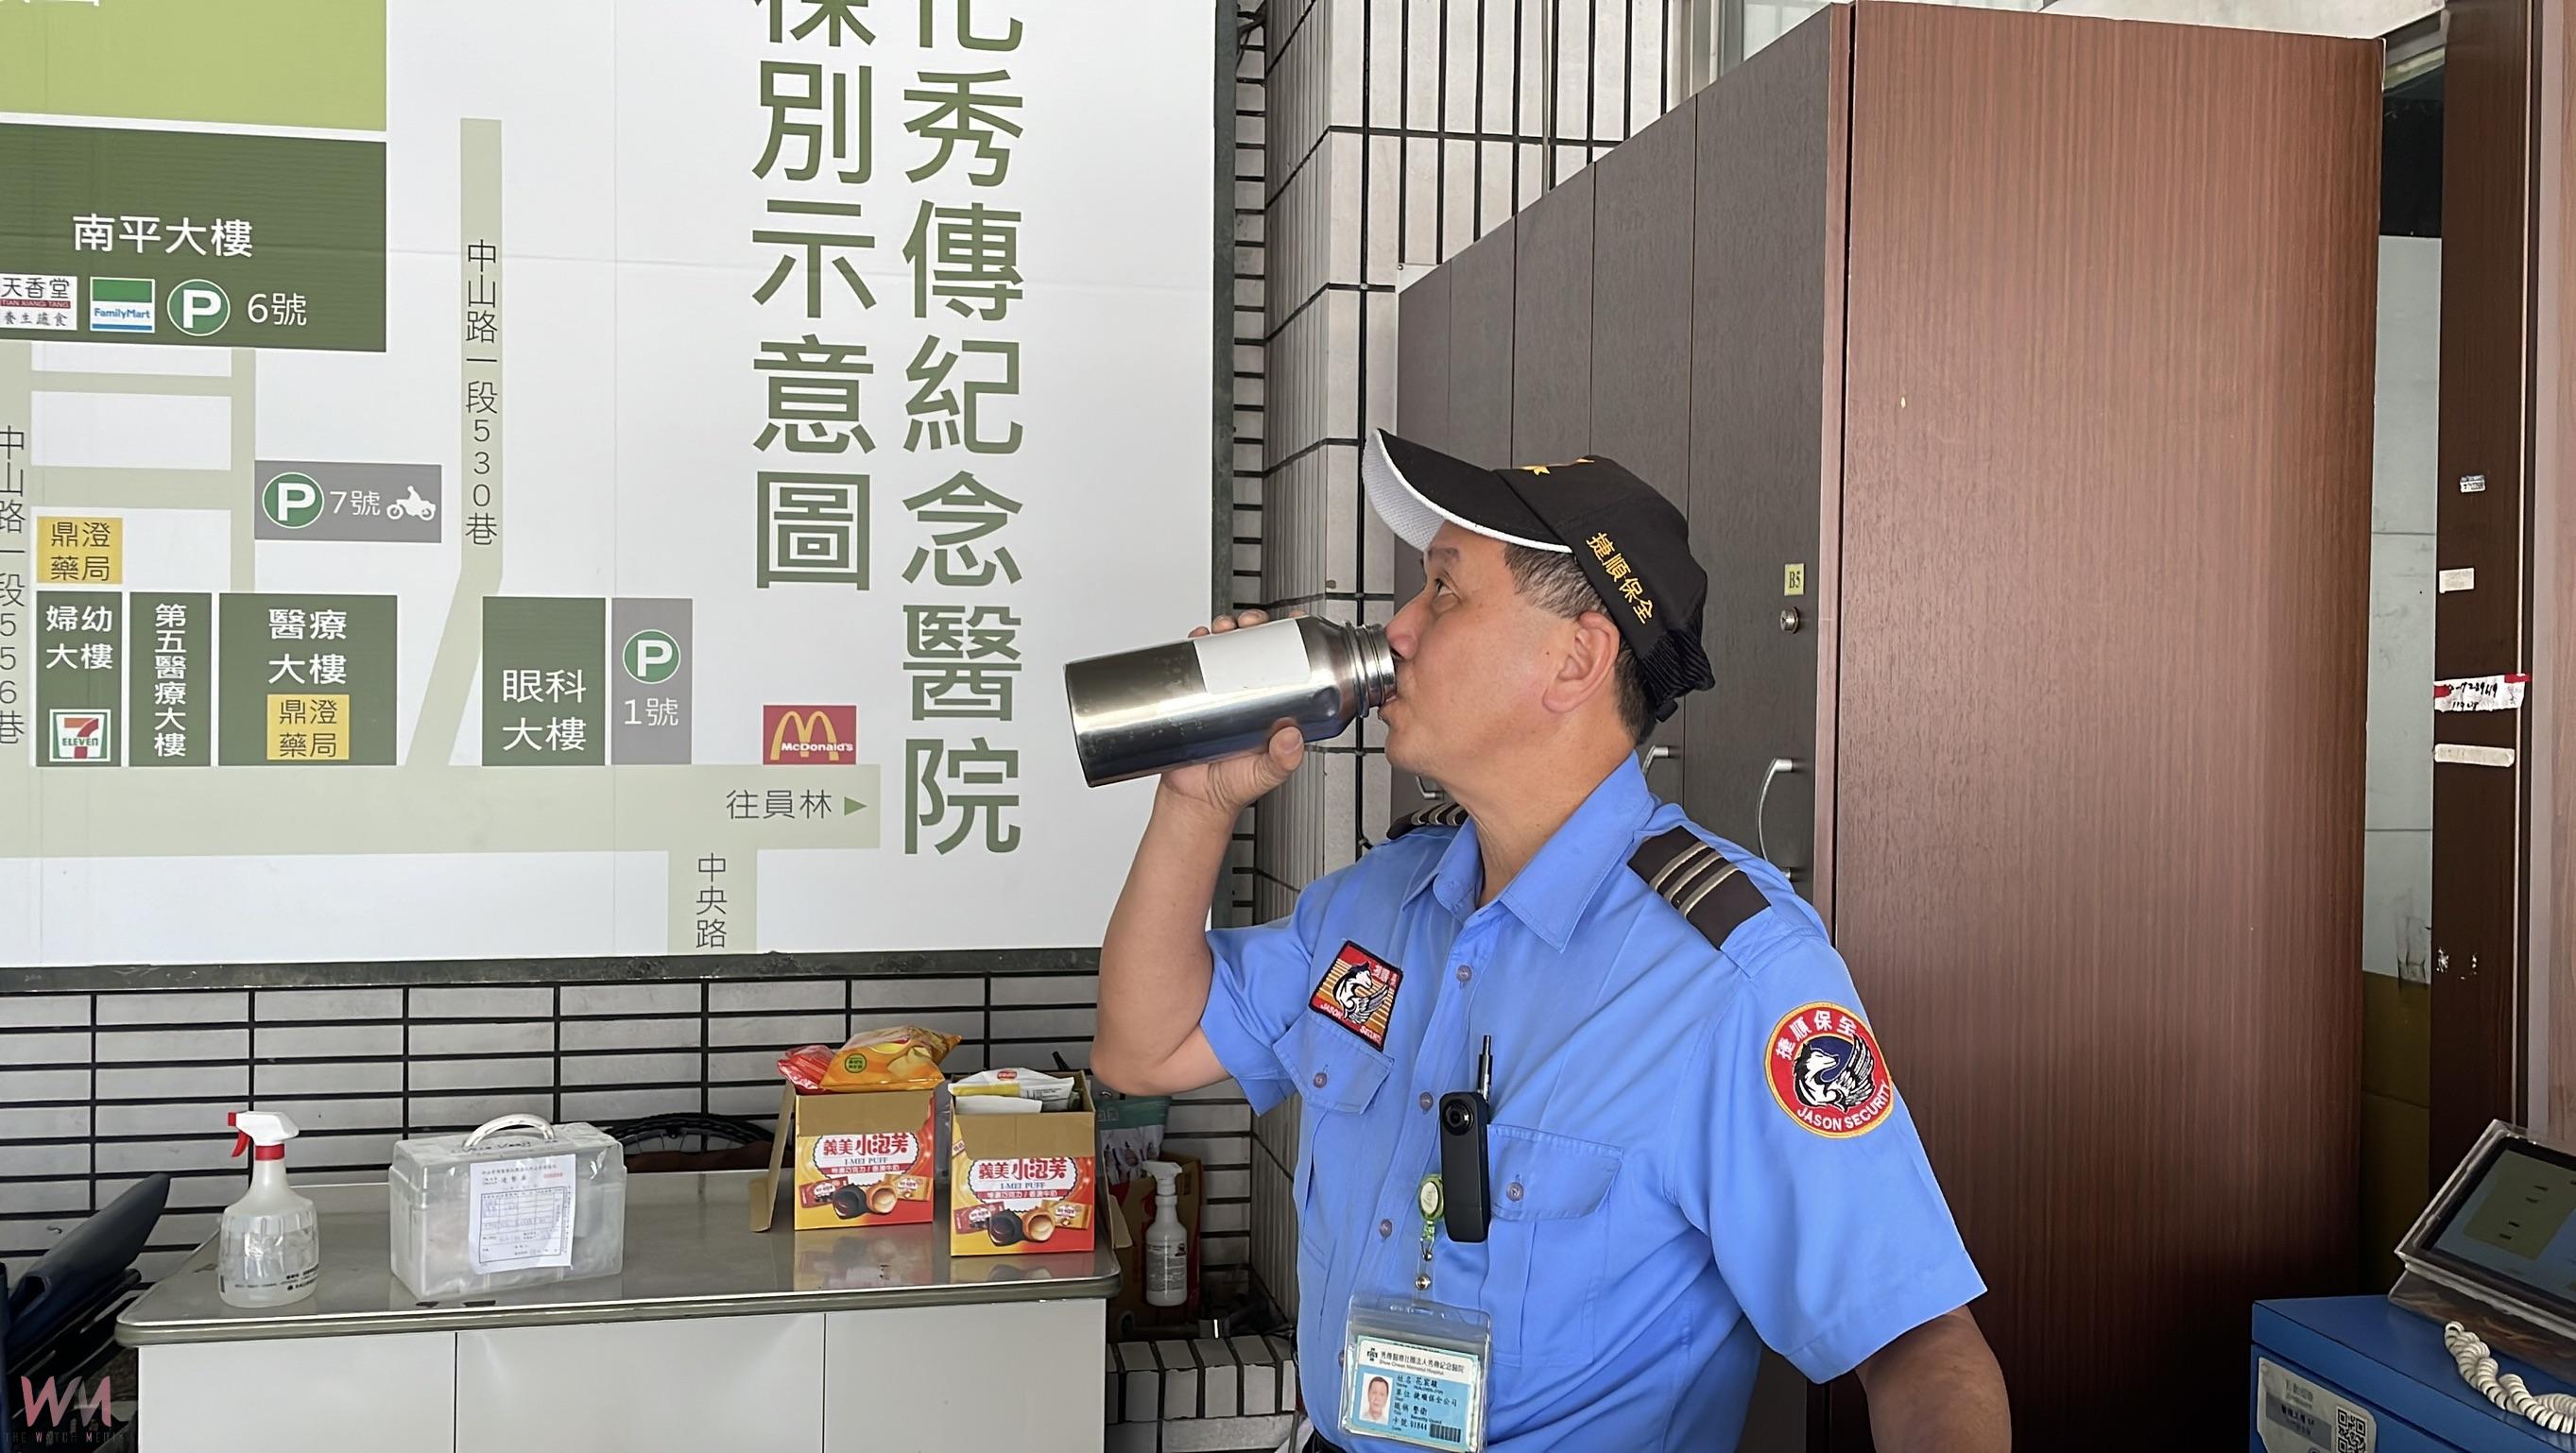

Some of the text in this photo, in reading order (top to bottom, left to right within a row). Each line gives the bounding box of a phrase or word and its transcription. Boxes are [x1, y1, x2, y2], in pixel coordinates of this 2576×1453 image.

[72, 213, 254, 258] 南平大樓
[1, 277, 70, 299] 天香堂
[94, 308, 151, 319] FamilyMart
[182, 288, 222, 328] P
[247, 292, 308, 326] 6號
[465, 239, 499, 546] 中山路一段530巷
[277, 482, 317, 521] P
[329, 489, 381, 517] 7號
[50, 521, 112, 548] 鼎澄
[50, 556, 111, 582] 藥局
[1586, 532, 1655, 624] 捷順保全
[1789, 571, 1801, 589] B5
[45, 605, 113, 633] 婦幼
[267, 608, 348, 641] 醫療
[45, 643, 114, 670] 大樓
[267, 654, 349, 686] 大樓
[637, 640, 673, 677] P
[154, 603, 187, 757] 第五醫療大樓
[502, 669, 587, 704] 眼科
[279, 699, 338, 726] 鼎澄
[623, 697, 679, 727] 1號
[279, 732, 337, 759] 藥局
[502, 716, 587, 752] 大樓
[781, 741, 854, 753] McDonald's
[726, 789, 833, 820] 往員林
[696, 853, 728, 950] 中央路
[1775, 1010, 1858, 1061] 捷順保全
[1796, 1079, 1891, 1131] JASON SECURITY
[823, 1133, 909, 1156] 義美小泡芙
[978, 1157, 1067, 1180] 義美小泡芙
